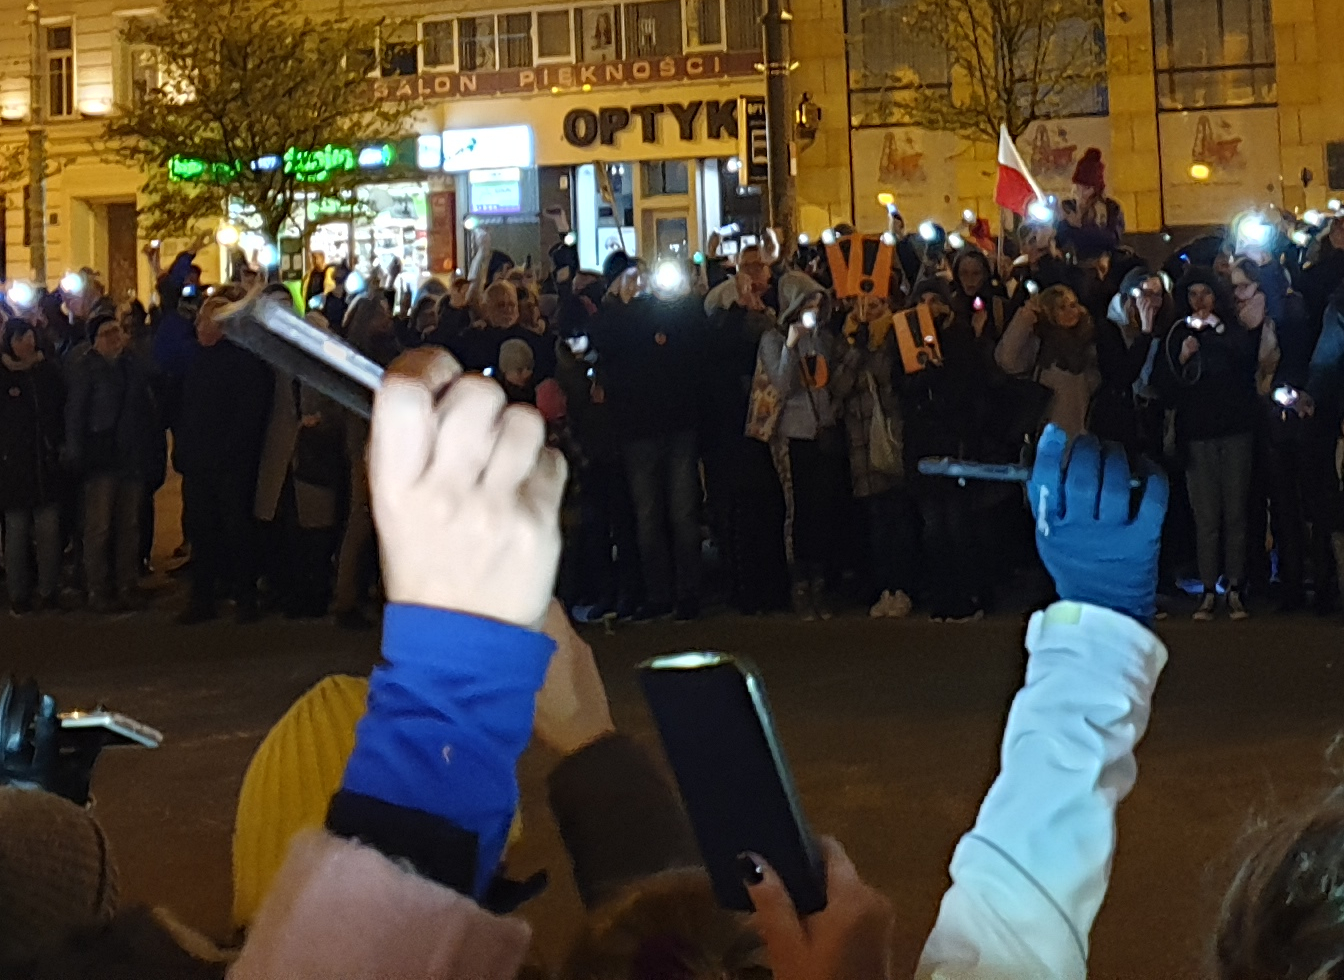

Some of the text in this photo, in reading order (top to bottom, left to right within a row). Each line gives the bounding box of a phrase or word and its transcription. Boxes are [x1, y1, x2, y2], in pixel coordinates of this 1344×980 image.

[373, 55, 724, 100] SALON PIĘKNOŚCI
[562, 98, 739, 149] OPTYK
